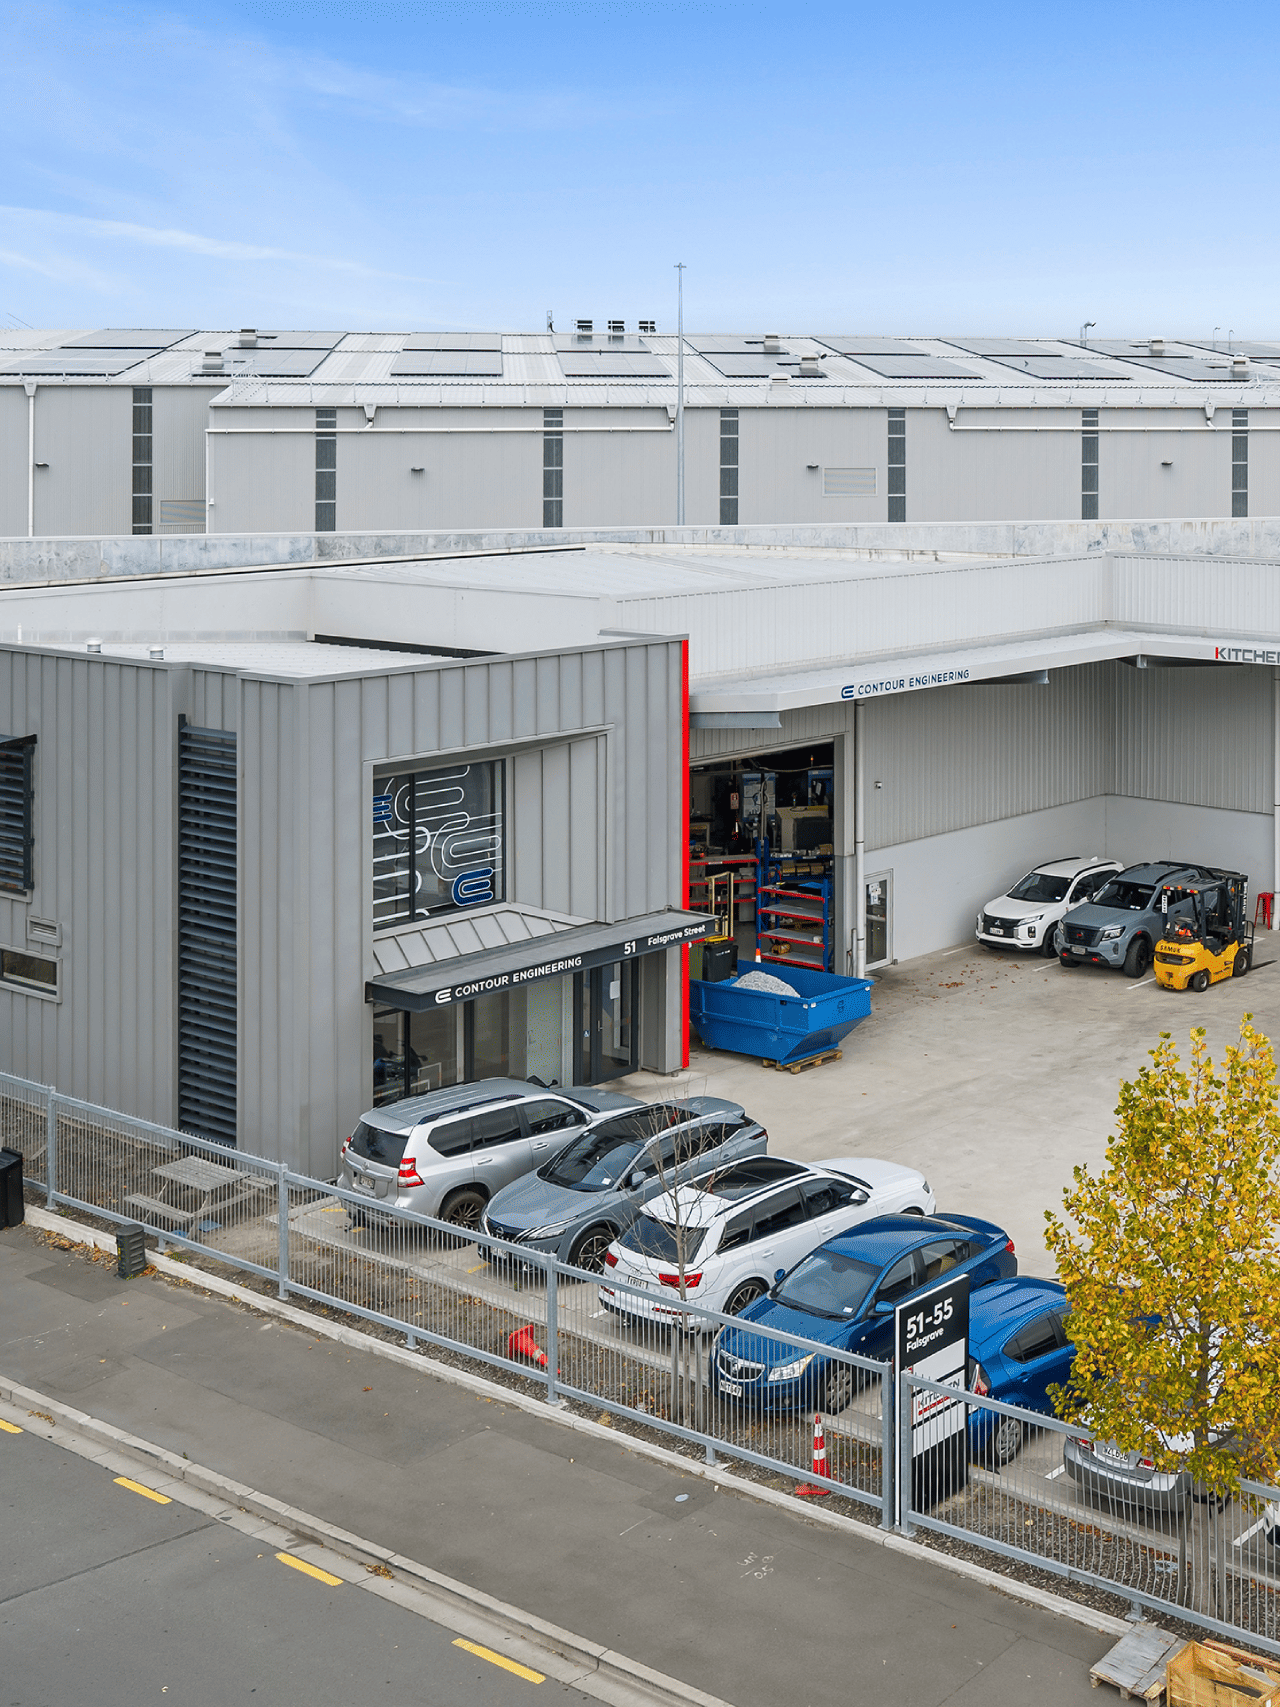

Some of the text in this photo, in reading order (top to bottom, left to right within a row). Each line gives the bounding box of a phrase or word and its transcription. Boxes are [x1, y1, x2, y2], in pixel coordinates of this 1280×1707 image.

[857, 669, 970, 695] CONTOUR ENGINEERING
[623, 941, 637, 955] 51
[648, 924, 706, 947] Falsgrave Street
[455, 956, 582, 997] CONTOUR ENGINEERING
[906, 1297, 954, 1339] 51-55
[906, 1327, 945, 1353] Falsgrave
